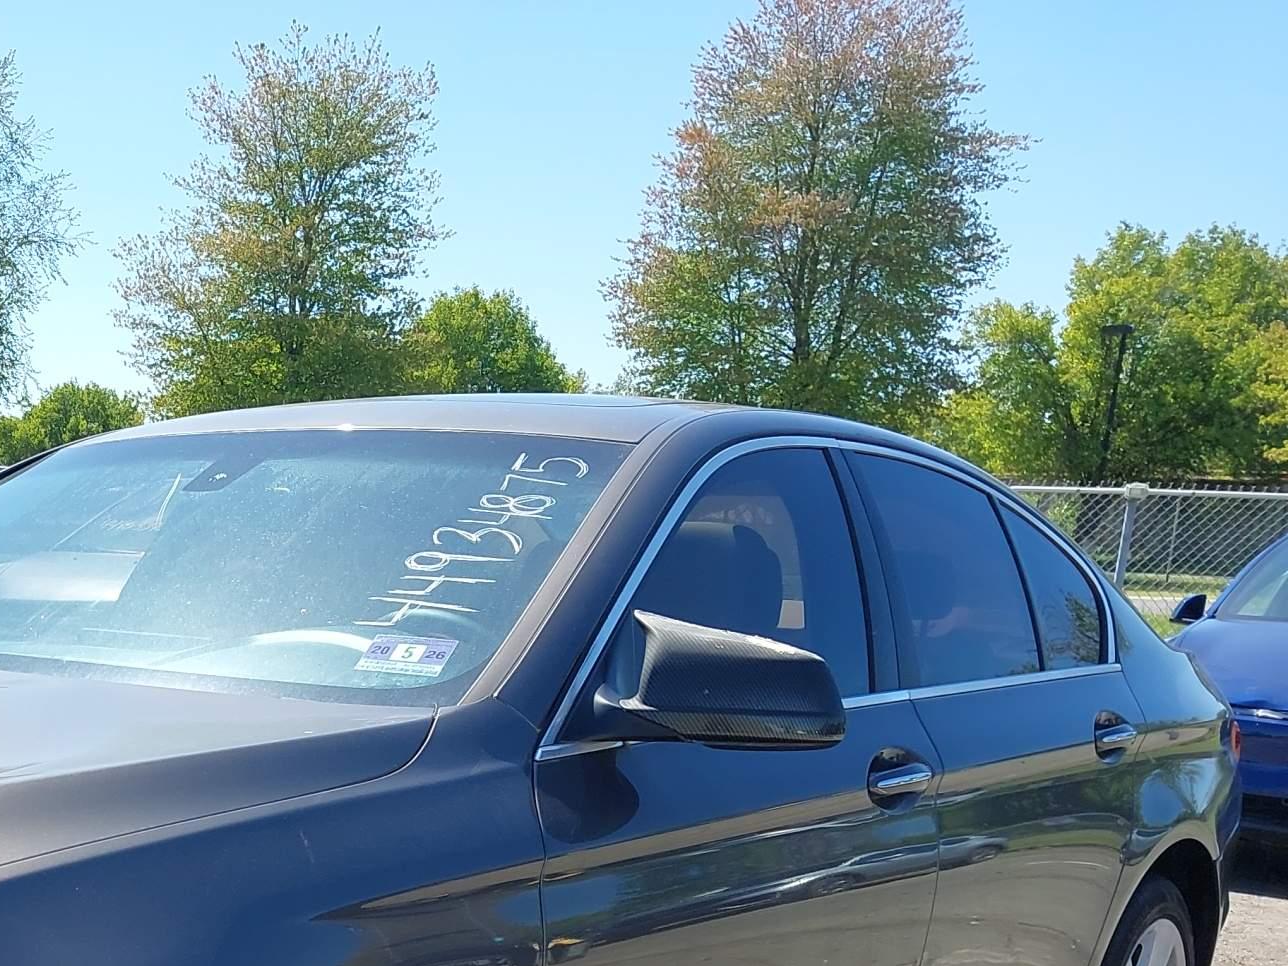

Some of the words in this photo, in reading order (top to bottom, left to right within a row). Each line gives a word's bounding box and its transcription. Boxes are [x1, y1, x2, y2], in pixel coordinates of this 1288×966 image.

[353, 452, 590, 626] 44934875
[371, 645, 391, 655] 20
[400, 646, 417, 659] 5
[425, 650, 447, 660] 26
